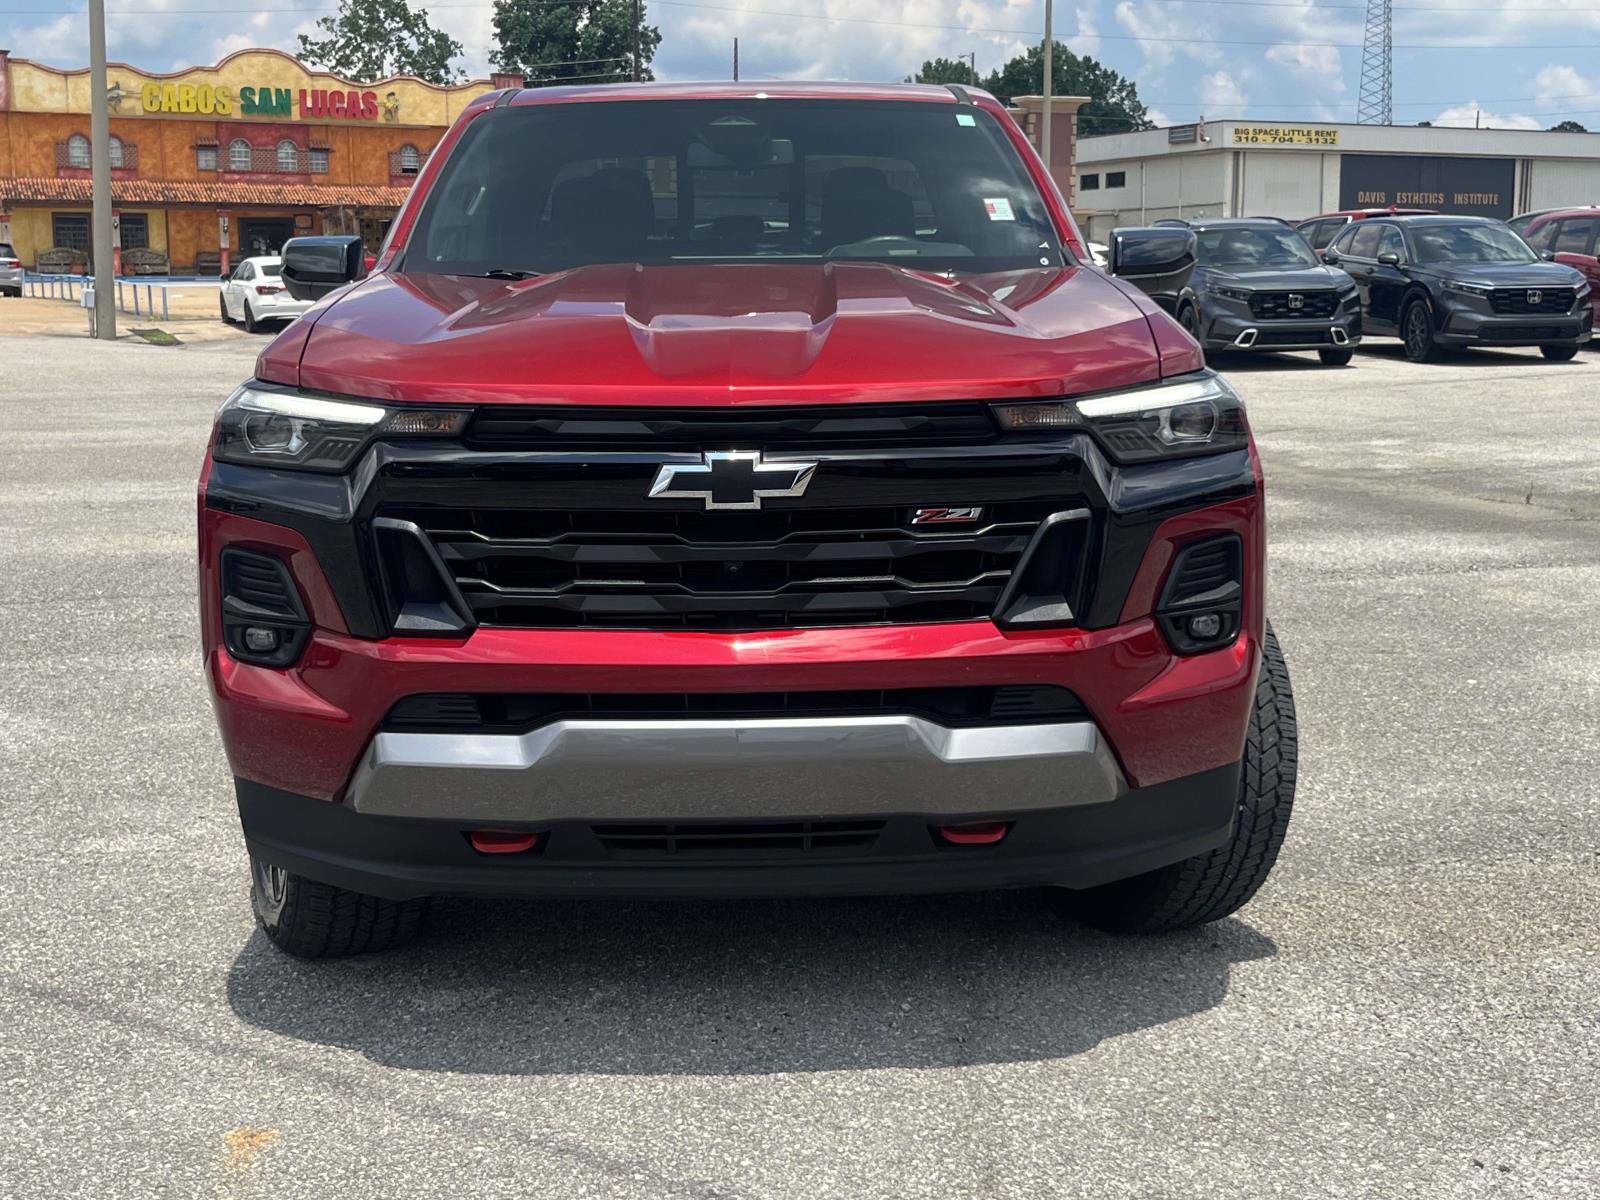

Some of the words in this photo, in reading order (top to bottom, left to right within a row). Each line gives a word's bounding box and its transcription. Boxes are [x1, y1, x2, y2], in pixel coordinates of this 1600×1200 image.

[142, 83, 232, 115] CABOS
[240, 86, 292, 115] SAN
[299, 88, 379, 120] LUCAS
[1235, 135, 1259, 143] 310
[1270, 136, 1294, 144] 704
[1252, 128, 1281, 136] SPACE
[1282, 129, 1312, 137] LITTLE
[1314, 130, 1338, 138] RENT
[1358, 191, 1386, 204] DAVIS
[1396, 192, 1445, 205] ESTHETICS
[1454, 193, 1500, 206] INSTITUTE
[911, 508, 982, 524] Z71
